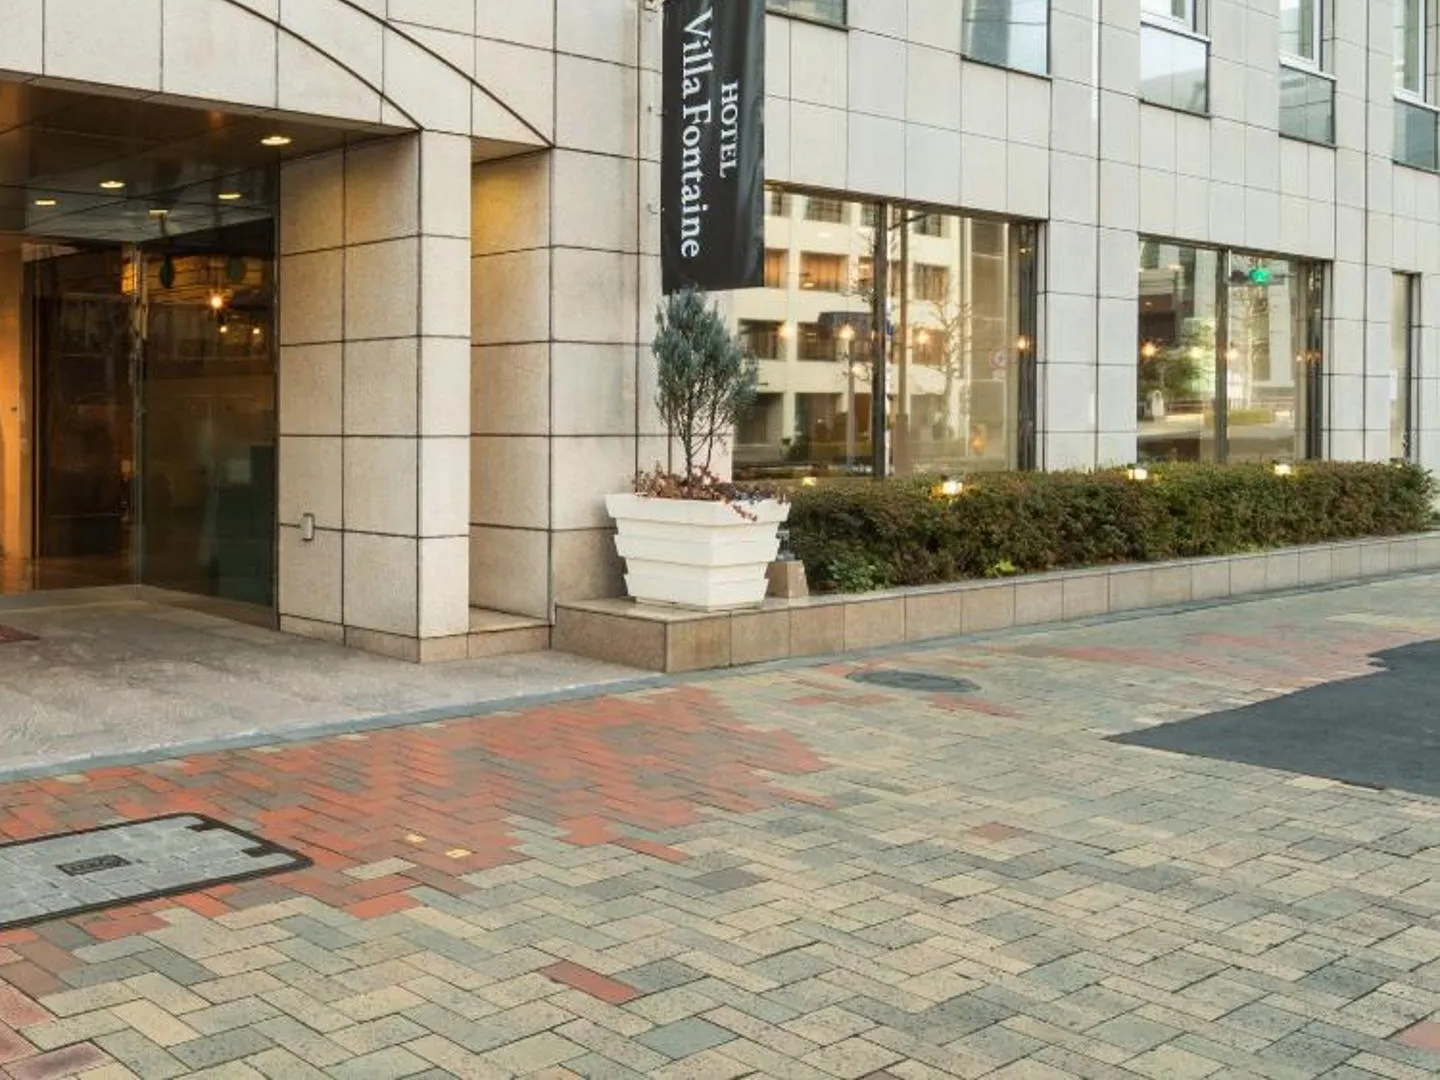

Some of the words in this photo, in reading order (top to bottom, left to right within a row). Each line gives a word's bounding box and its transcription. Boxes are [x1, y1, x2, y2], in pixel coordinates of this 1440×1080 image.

[681, 7, 714, 97] Villa
[680, 98, 712, 257] Fontaine
[719, 81, 739, 178] HOTEL
